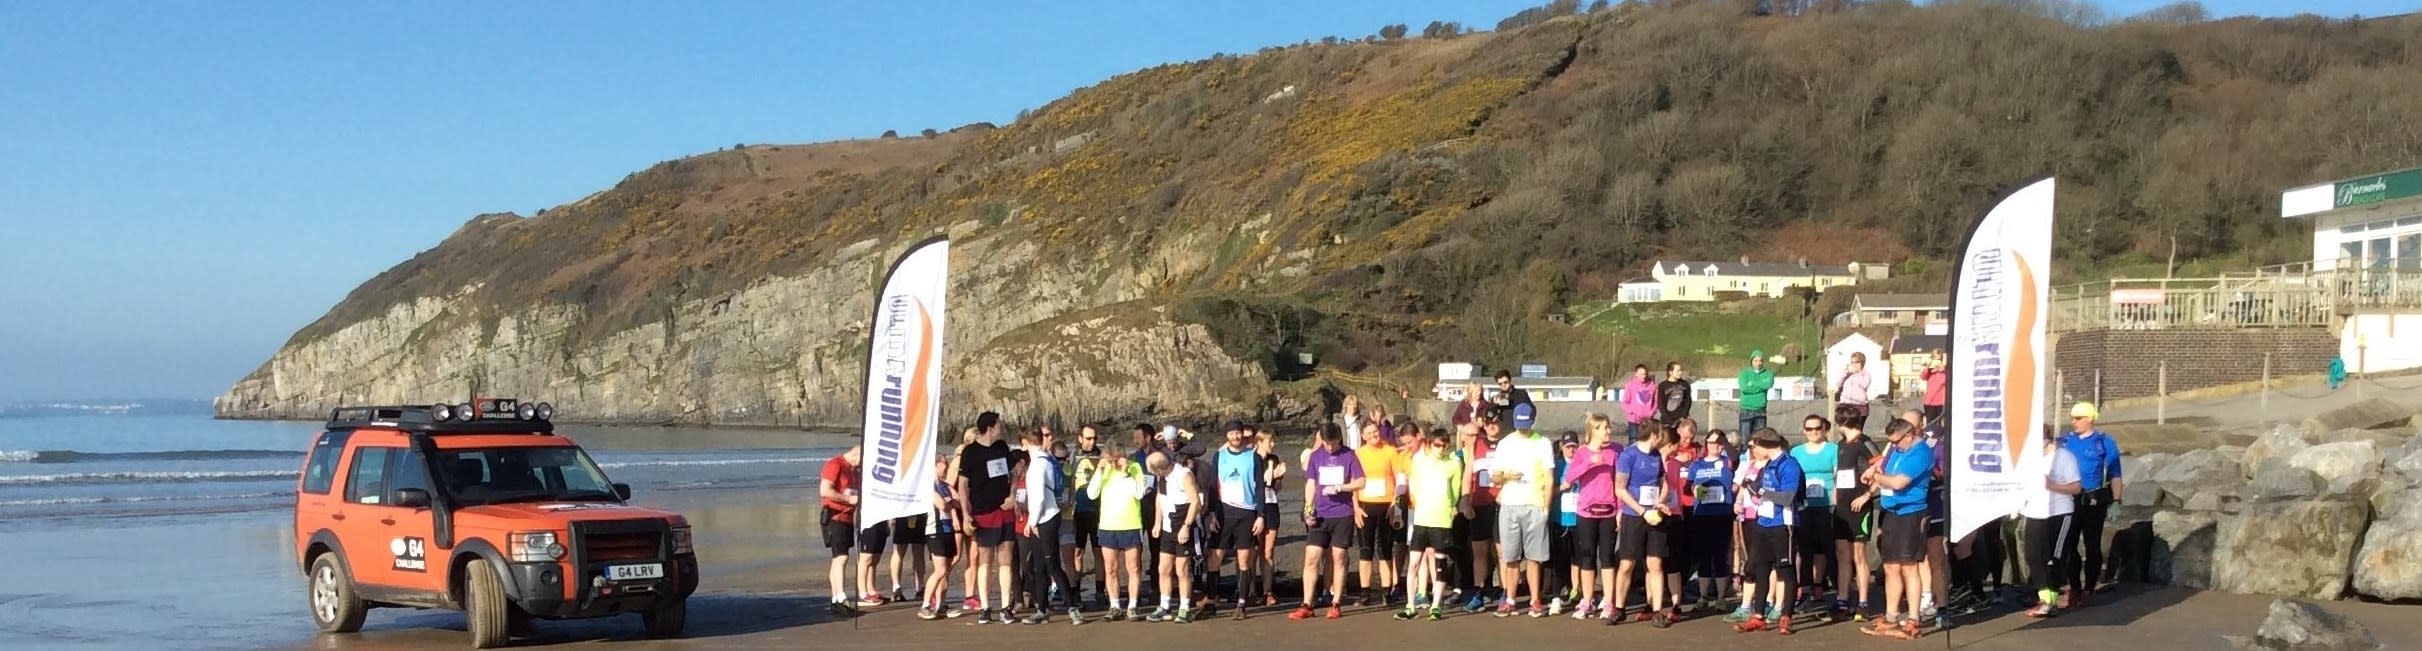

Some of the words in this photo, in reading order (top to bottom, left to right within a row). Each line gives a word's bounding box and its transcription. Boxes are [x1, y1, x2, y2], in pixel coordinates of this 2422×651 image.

[499, 401, 515, 411] G4
[409, 539, 424, 557] G4
[618, 566, 632, 577] G4
[633, 565, 654, 577] LRV
